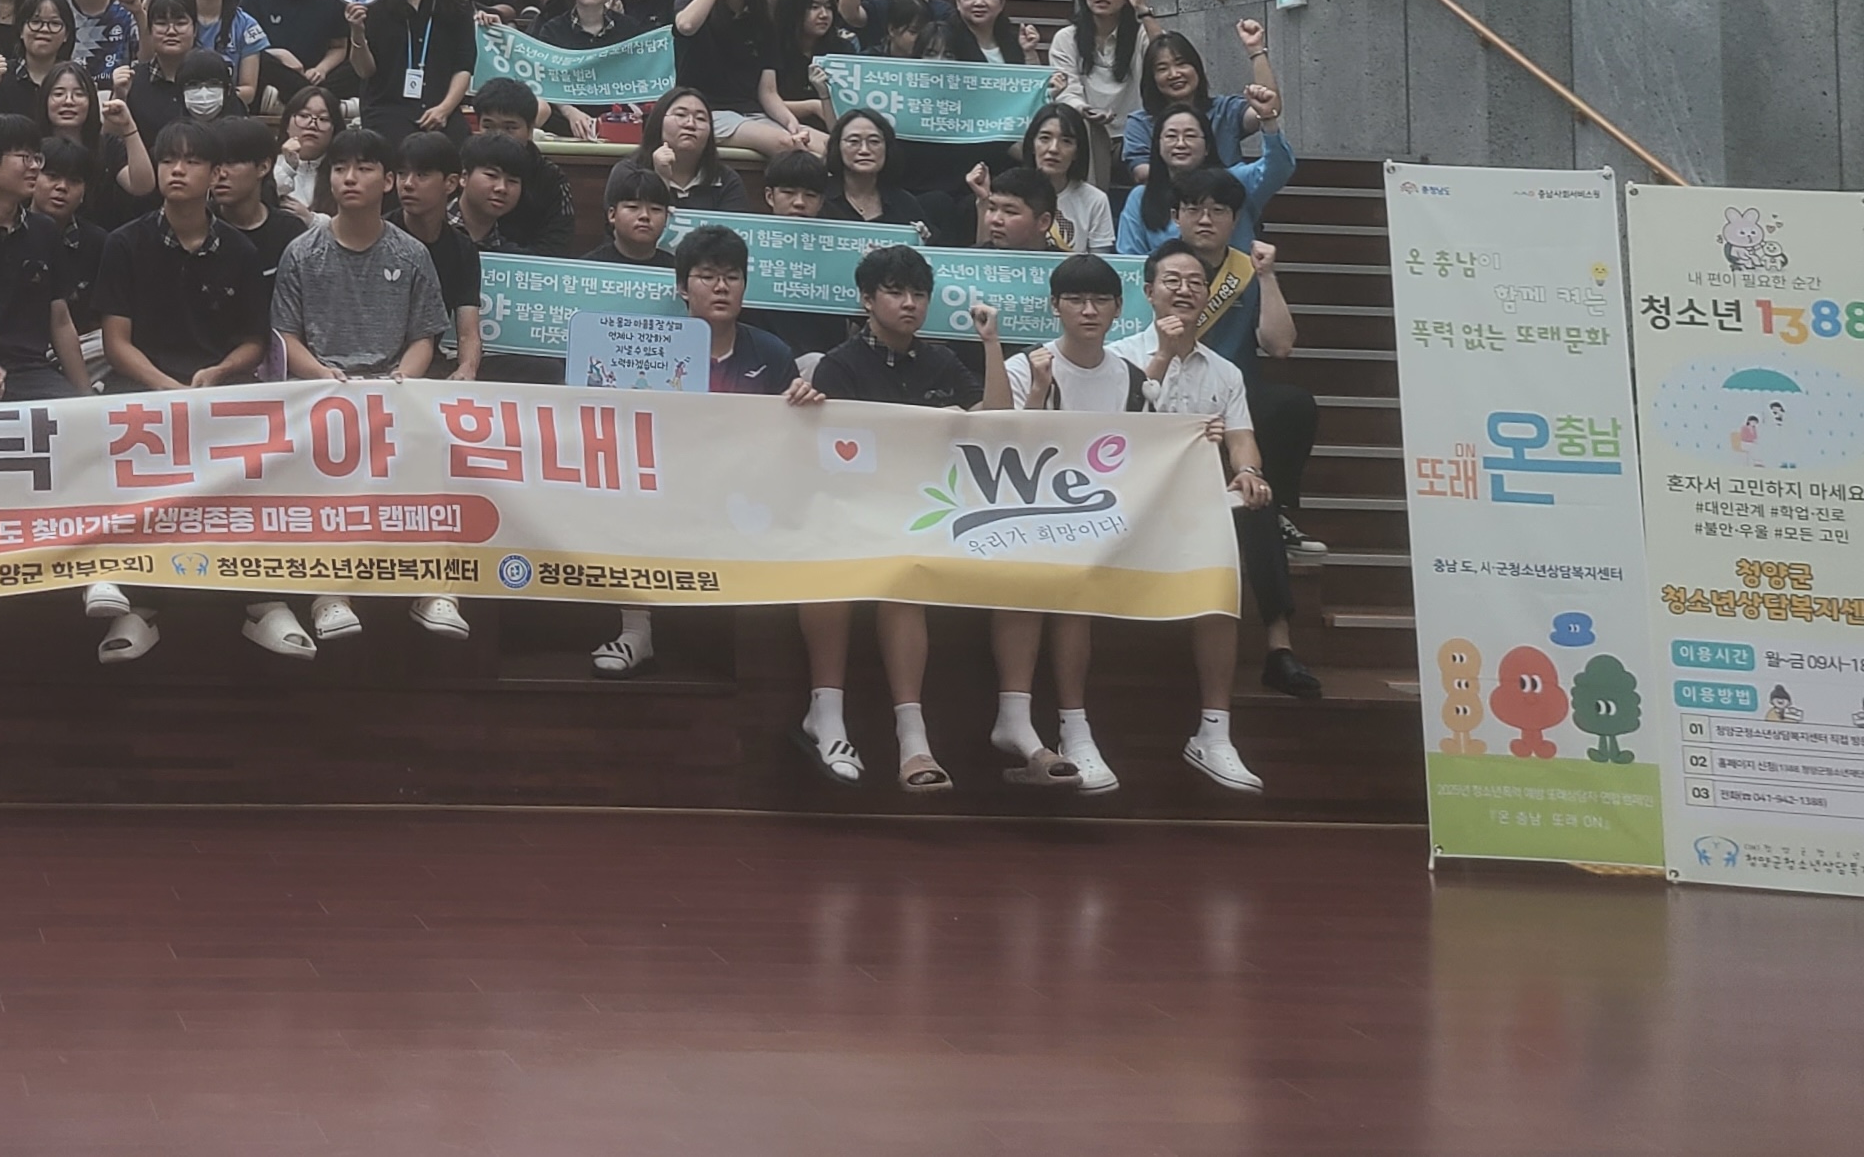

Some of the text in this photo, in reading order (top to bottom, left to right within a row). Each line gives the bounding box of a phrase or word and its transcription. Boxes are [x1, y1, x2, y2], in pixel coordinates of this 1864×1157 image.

[563, 81, 610, 96] 따뜻하게
[612, 80, 649, 95] 안아줄
[863, 70, 902, 84] 소년이
[905, 72, 944, 89] 힘들어
[946, 75, 960, 90] 할
[963, 75, 977, 90] 땐
[907, 98, 962, 116] 팔을 벌려
[921, 117, 1015, 134] 따뜻하게 안아줄
[757, 229, 834, 252] 힘들어 할 땐
[759, 259, 817, 279] 팔을 벌려
[1405, 248, 1501, 278] 온 충남이
[937, 264, 1046, 284] 소년이 힘들어 할
[1688, 272, 1822, 291] 내 편이 필요한 순간
[515, 271, 559, 291] 힘들어
[562, 275, 579, 293] 할
[581, 278, 597, 294] 땐
[600, 280, 678, 300] 또래상담자
[774, 281, 829, 301] 따뜻하게
[1020, 296, 1048, 312] 벌려
[1495, 284, 1546, 314] 함께
[515, 303, 547, 322] 팔을
[600, 317, 615, 327] 나는
[1641, 295, 1743, 332] 청소년
[1002, 315, 1060, 333] 따뜻하게
[608, 331, 672, 344] 언제나 건강하게
[1411, 319, 1454, 348] 폭력
[1462, 323, 1506, 352] 없는
[634, 346, 642, 354] 수
[644, 346, 666, 358] 있도록
[610, 357, 669, 371] 노력하겠습니다!
[107, 393, 396, 488] 친구야
[439, 397, 658, 492] 힘내!
[1554, 414, 1622, 458] 충남
[1416, 411, 1622, 505] 또래 온
[1666, 474, 1864, 501] 혼자서 고민하지 마세요
[1696, 501, 1765, 517] #대인관계
[31, 514, 137, 542] 찾아가는
[142, 503, 254, 535] [생명존중
[262, 505, 314, 533] 마음
[319, 505, 371, 533] 허그
[378, 503, 461, 534] 캠페인]
[969, 515, 1128, 556] 우리가 희망이다!
[1774, 527, 1813, 542] #모든
[1820, 529, 1849, 544] 고민
[217, 555, 479, 583] 청양군청소년상담복지센터
[1433, 559, 1457, 573] 충남
[1736, 558, 1813, 590] 청양군
[538, 563, 720, 592] 청양군보건의료원
[1679, 646, 1749, 665] 이용시간
[1682, 686, 1751, 705] 이용방법
[1689, 723, 1703, 735] 01
[1689, 756, 1707, 767] 02
[1692, 787, 1709, 799] 03
